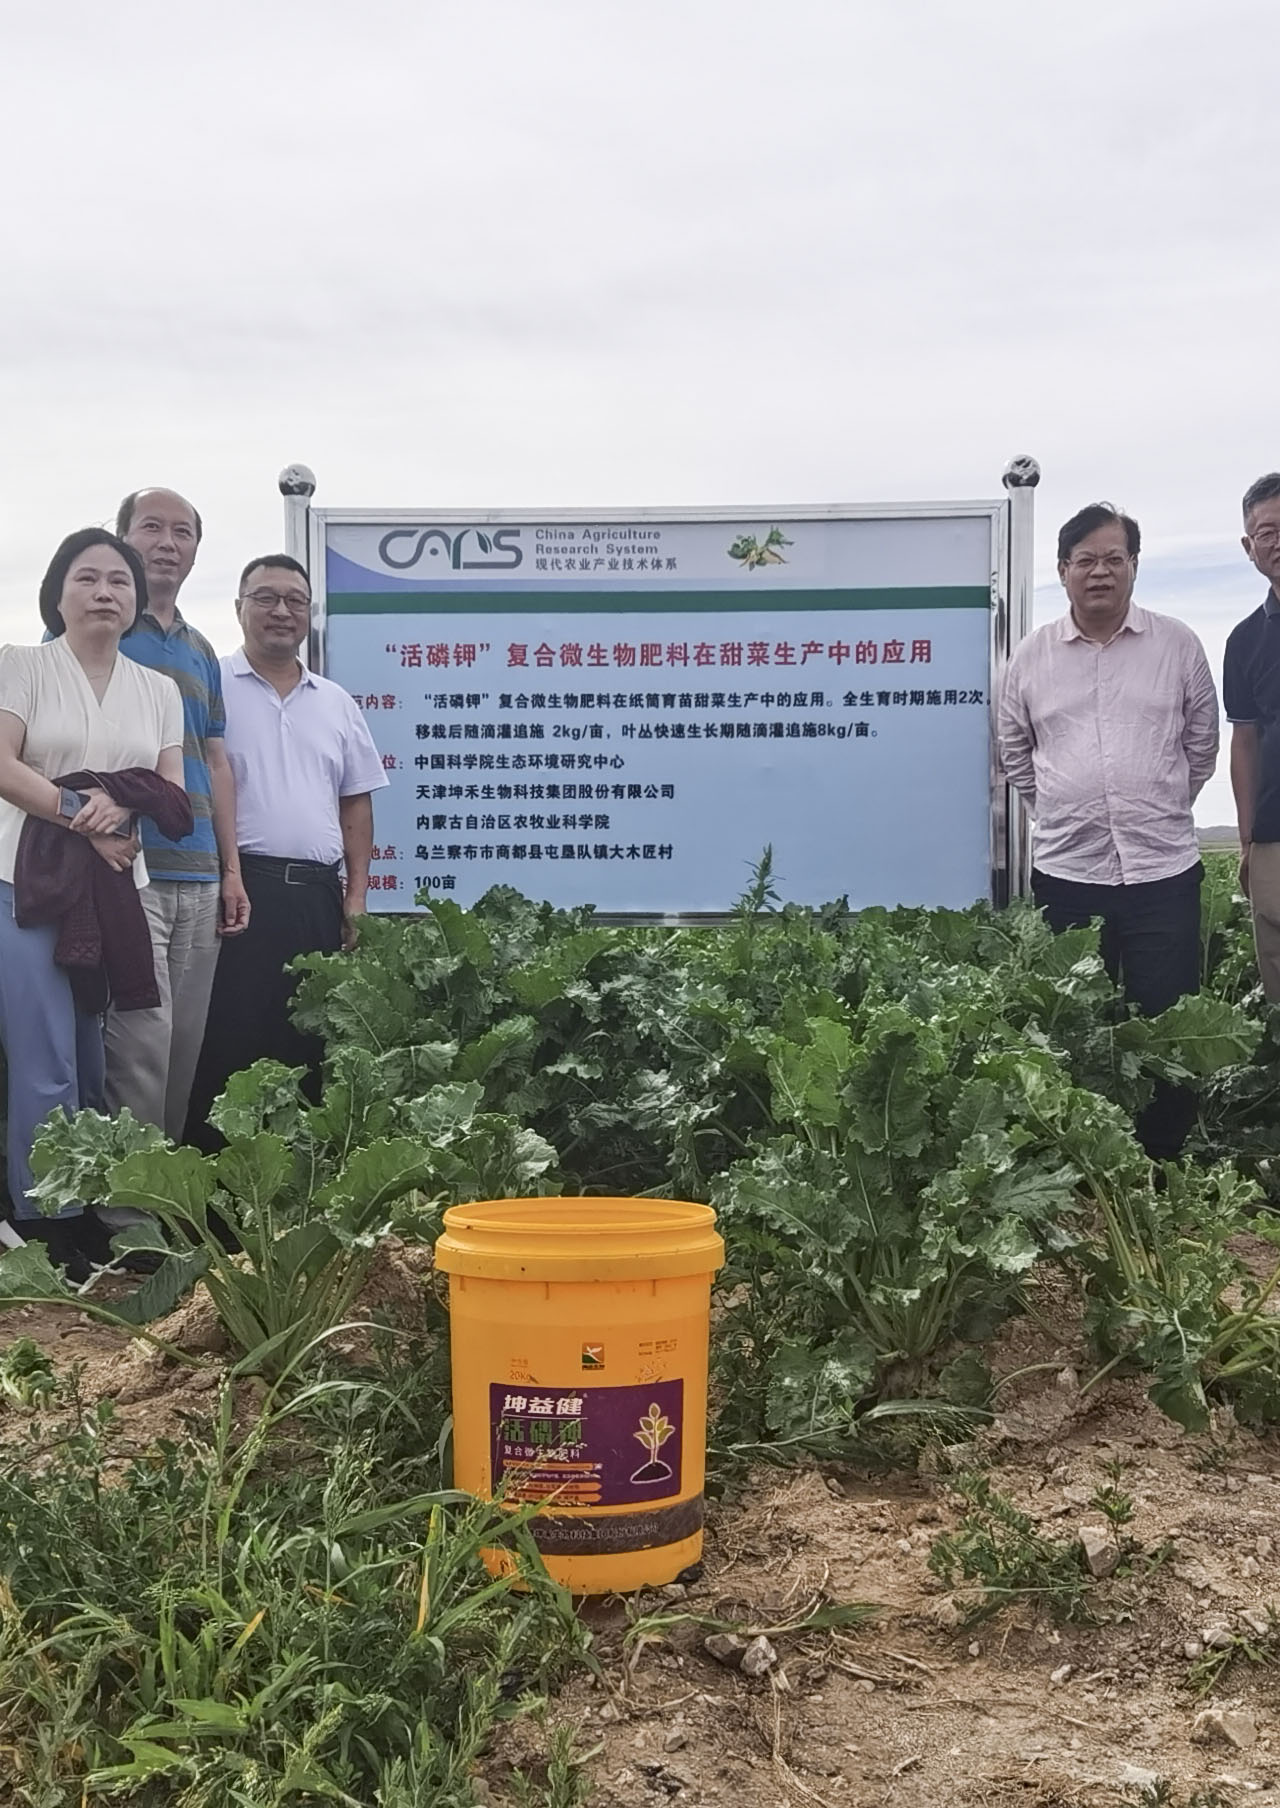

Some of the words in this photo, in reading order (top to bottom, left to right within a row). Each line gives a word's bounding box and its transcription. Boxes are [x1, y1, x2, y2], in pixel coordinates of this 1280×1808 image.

[535, 529, 575, 541] China
[582, 528, 661, 543] Agriculture
[535, 543, 599, 555] Research
[606, 543, 658, 557] System
[535, 557, 678, 571] 现代农业产业技术体系
[382, 754, 405, 770] 位：
[414, 753, 625, 770] 中国科学院生态环境研究中心
[416, 783, 675, 800] 天津坤禾生物科技集团股份有限公司
[416, 814, 610, 830] 内蒙古自治区农牧业科学院
[414, 843, 674, 860] 乌兰察布市商都县屯垦队镇大木匠村
[414, 875, 456, 890] 100亩
[504, 1394, 584, 1416] 坤益健
